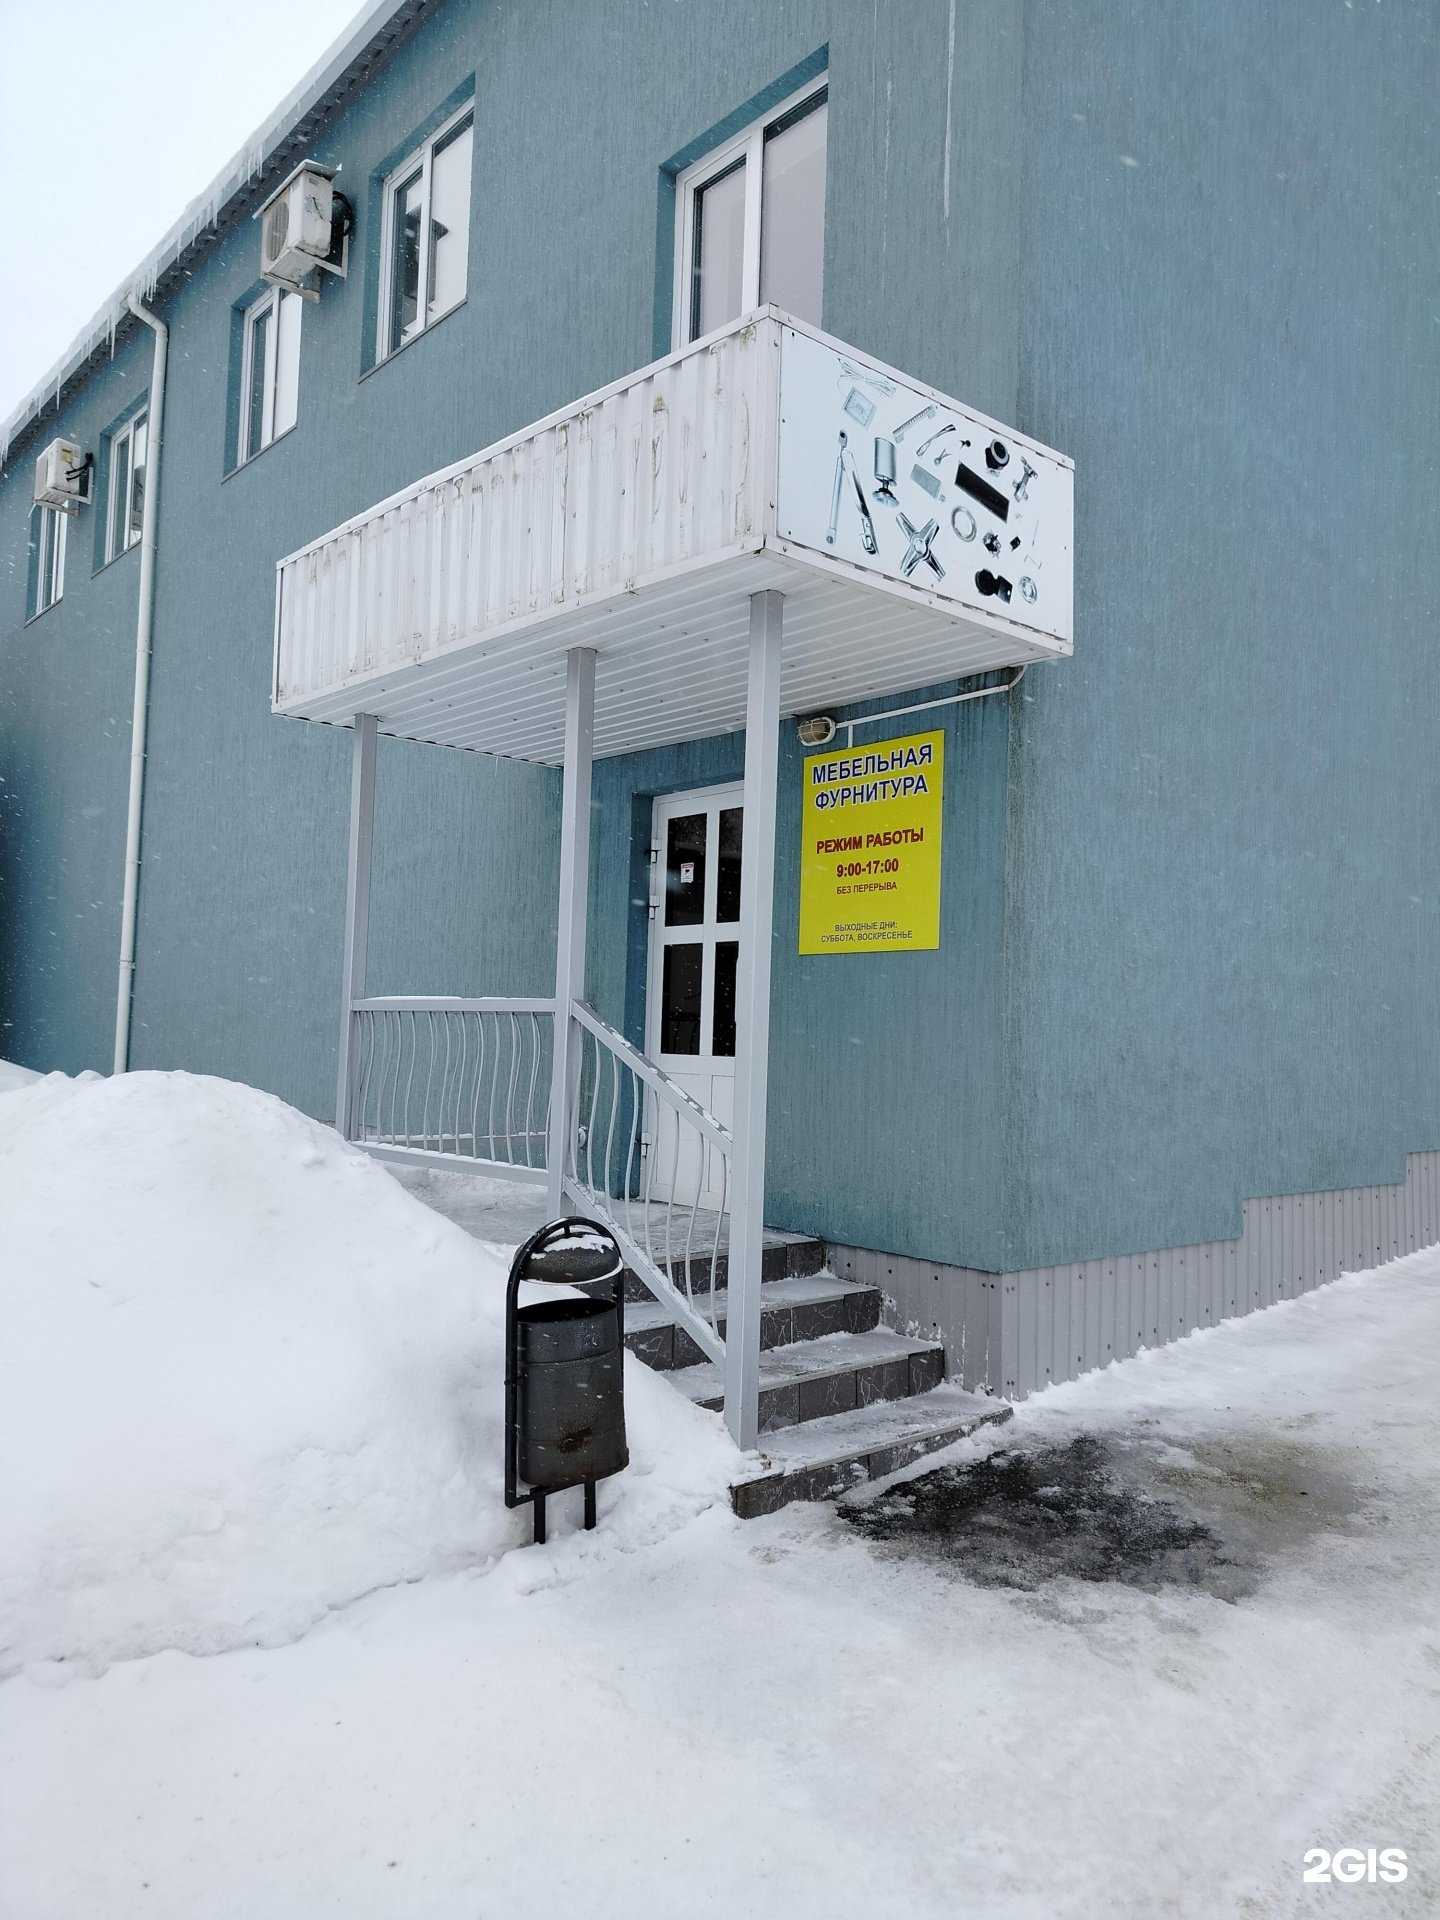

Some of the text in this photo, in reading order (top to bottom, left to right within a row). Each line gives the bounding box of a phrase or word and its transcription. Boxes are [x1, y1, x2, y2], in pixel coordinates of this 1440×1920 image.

[812, 744, 933, 785] МЕБЕЛЬНАЯ
[815, 774, 928, 810] ФУРНИТУРА
[816, 827, 924, 854] РЕЖИМ РАБОТЫ
[836, 858, 899, 877] 9:00-17:00
[836, 881, 898, 895] БЕЗ ПЕРЕРЫВА
[834, 920, 898, 932] ВЫХОДНЫЕ ДНИ:
[821, 930, 913, 943] СУББОТА, ВОСКРЕСЕНЬЕ
